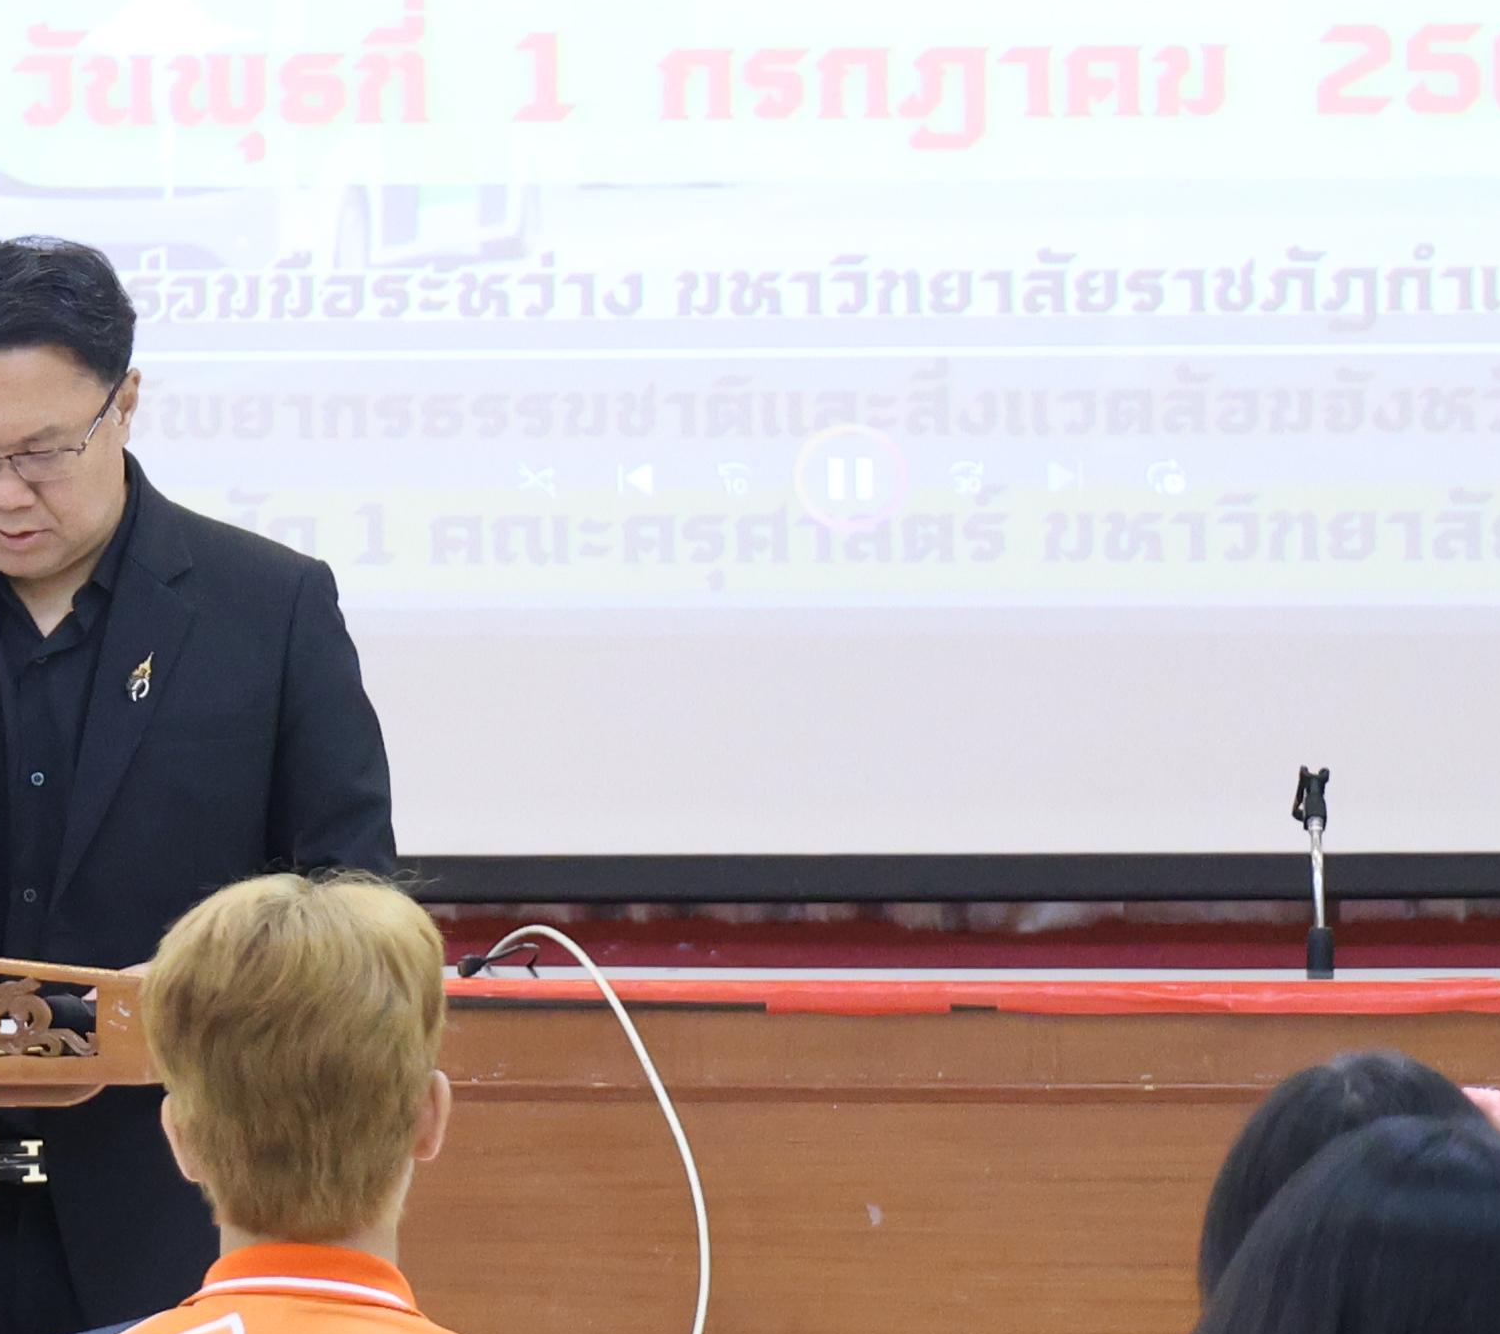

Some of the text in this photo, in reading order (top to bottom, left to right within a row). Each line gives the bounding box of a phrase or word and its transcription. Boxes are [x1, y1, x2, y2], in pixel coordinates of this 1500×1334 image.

[512, 30, 577, 124] 1
[656, 42, 1230, 152] กรกฎาคม
[352, 502, 396, 566] 1
[427, 483, 1009, 593] คณะครุศาสตร์
